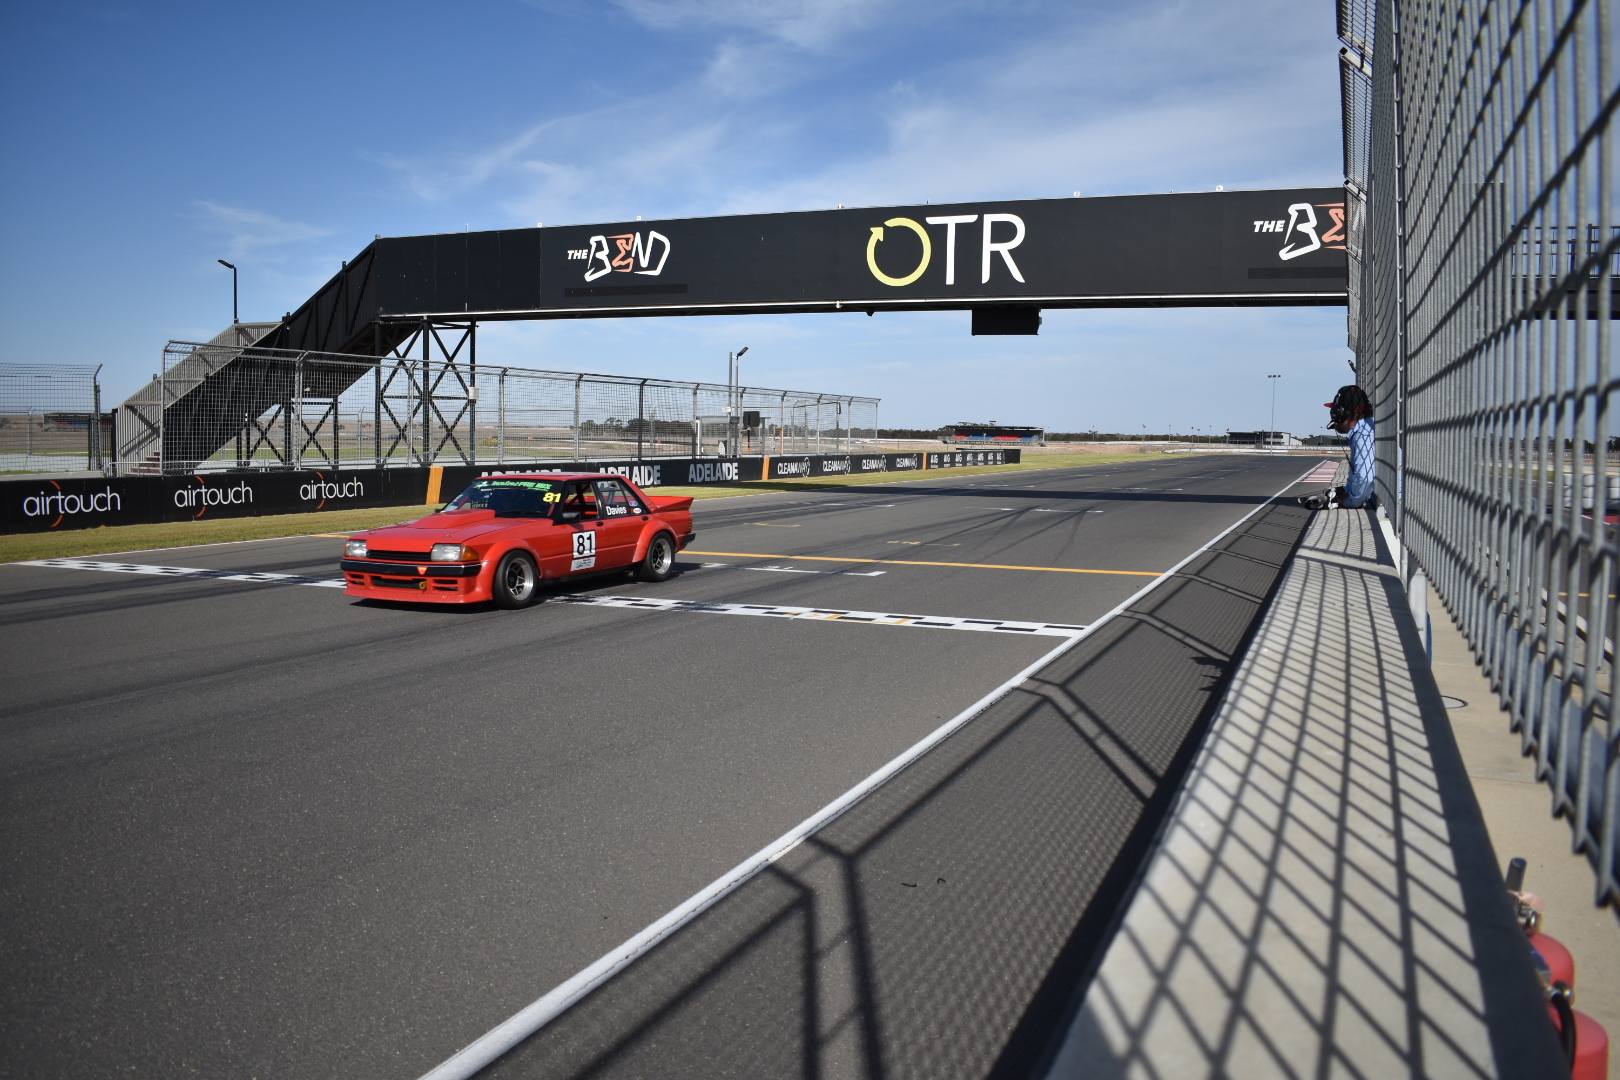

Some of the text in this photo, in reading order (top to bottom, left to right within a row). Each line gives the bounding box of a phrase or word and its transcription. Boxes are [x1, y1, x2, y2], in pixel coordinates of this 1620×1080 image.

[1253, 203, 1345, 261] THE BE
[567, 230, 671, 282] THE BEND
[867, 213, 1026, 287] OTR
[688, 462, 739, 483] ADELAIDE
[777, 461, 810, 474] CLEANAWAY
[23, 486, 121, 518] airtouch
[174, 481, 253, 508] airtouch
[300, 477, 364, 502] airtouch
[542, 492, 562, 503] 81
[605, 504, 628, 516] Davies
[577, 533, 593, 555] 81
